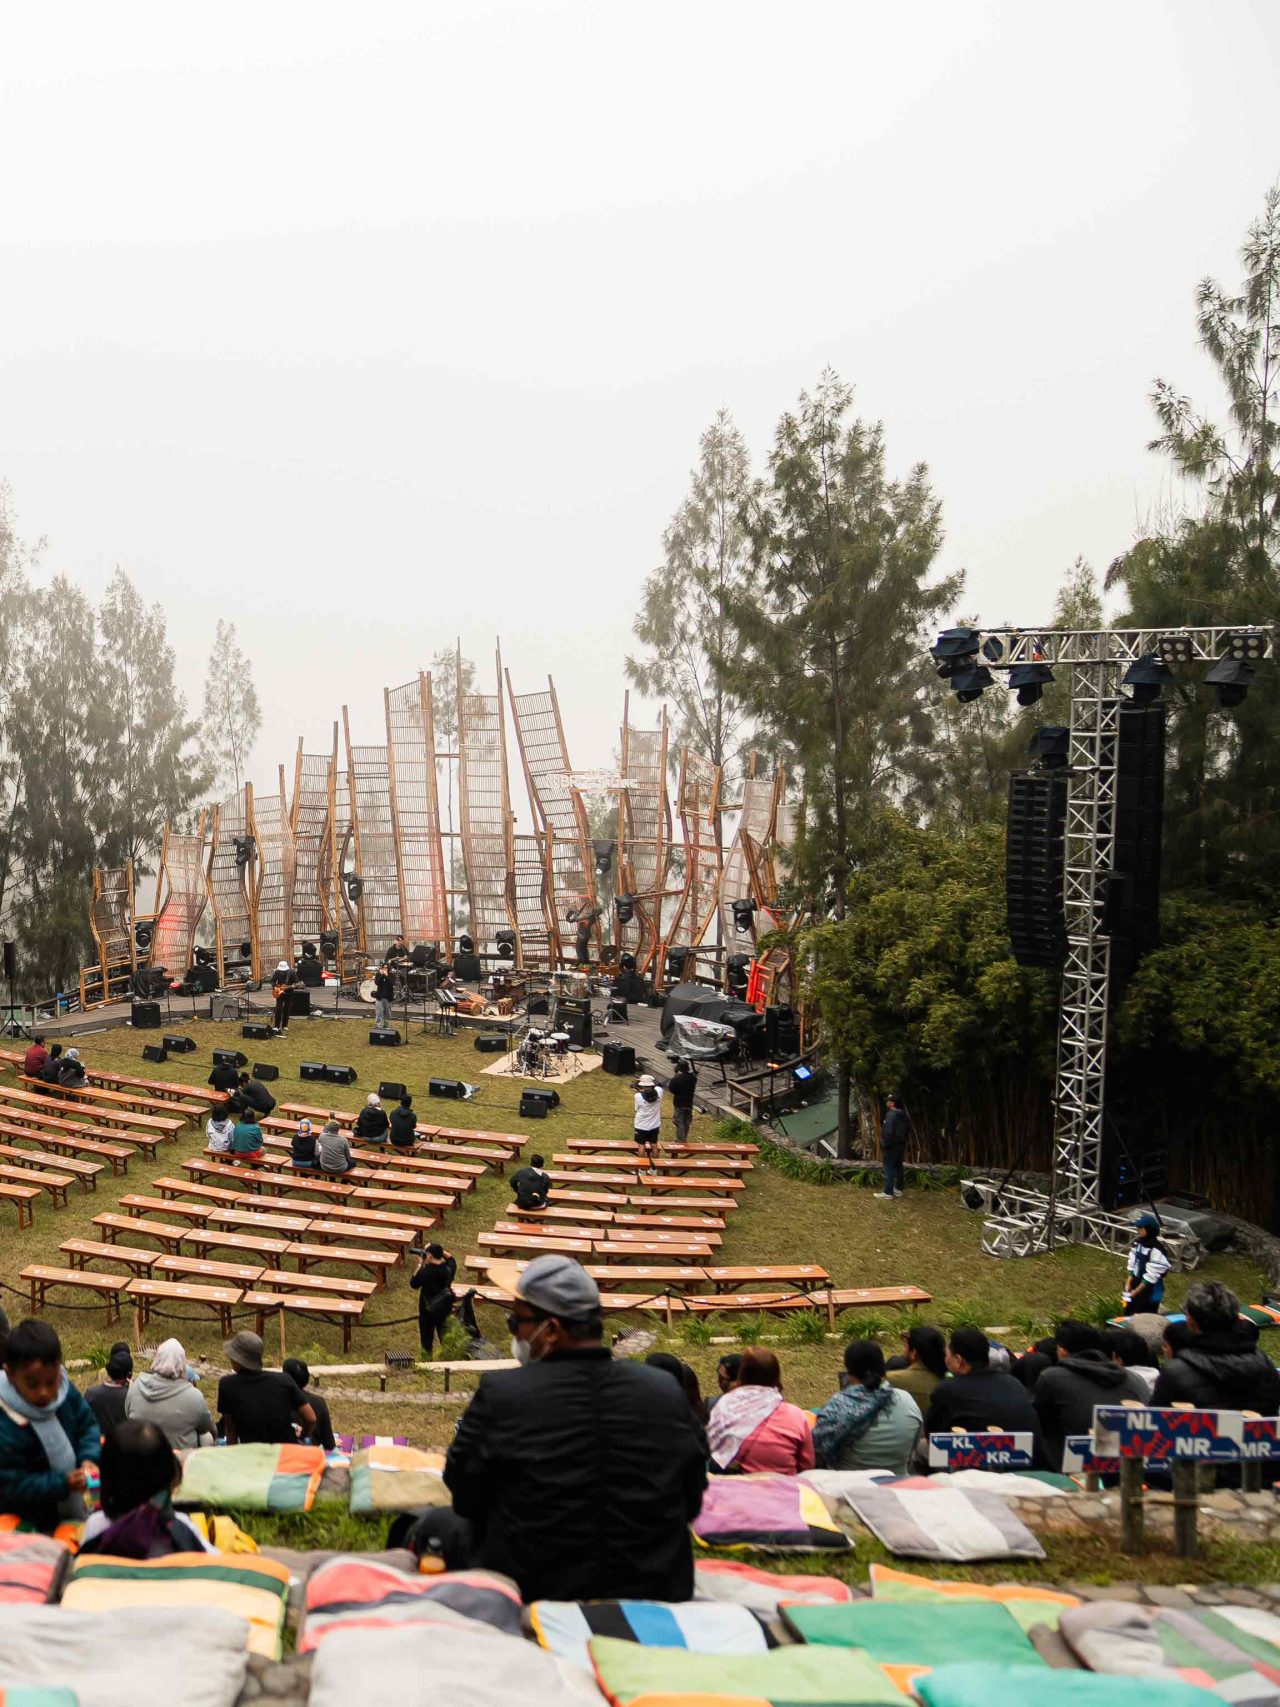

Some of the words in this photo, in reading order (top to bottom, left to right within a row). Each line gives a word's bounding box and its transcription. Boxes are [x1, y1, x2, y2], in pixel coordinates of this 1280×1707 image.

[1127, 1412, 1159, 1430] NL
[952, 1436, 974, 1449] KL
[1175, 1437, 1211, 1456] NR
[1240, 1441, 1272, 1457] MR
[986, 1451, 1011, 1464] KR
